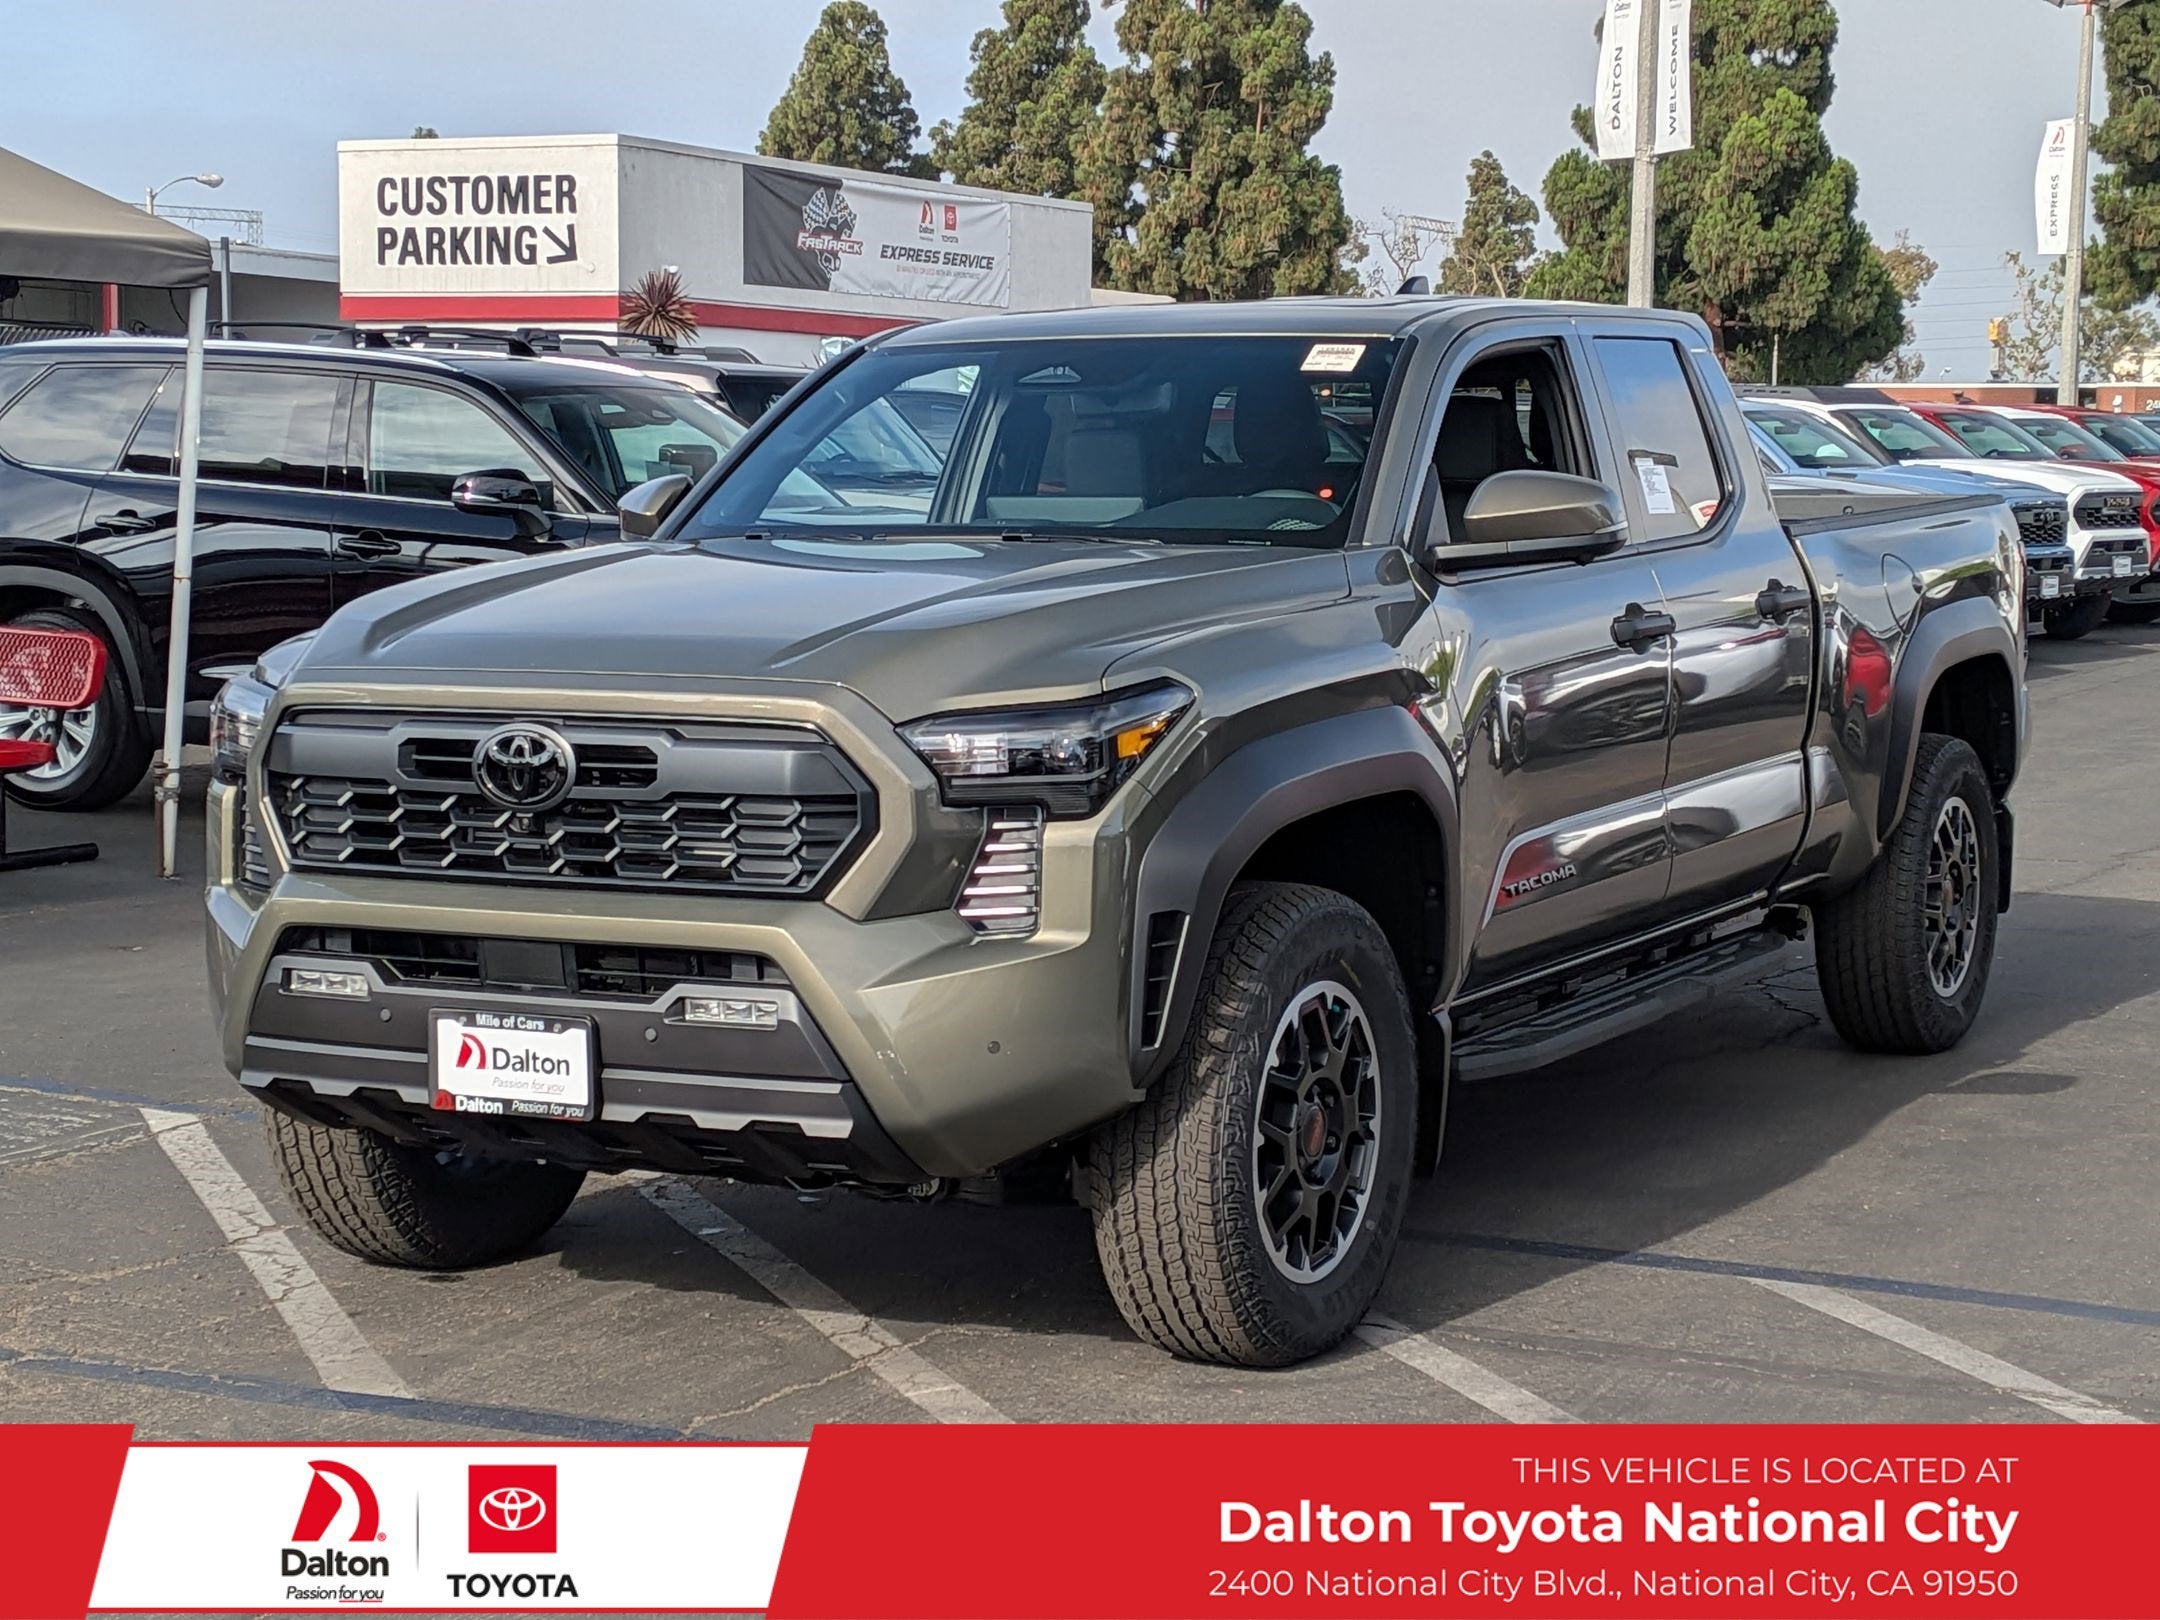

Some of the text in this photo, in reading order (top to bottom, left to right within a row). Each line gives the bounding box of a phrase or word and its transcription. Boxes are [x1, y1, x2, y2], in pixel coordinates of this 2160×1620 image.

[1611, 46, 1624, 130] DALTON
[1668, 24, 1680, 136] WELCOME
[377, 175, 578, 216] CUSTOMER
[2049, 174, 2060, 237] EXPRESS
[377, 226, 538, 266] PARKING
[880, 244, 995, 271] EXPRESS SERVICE
[1505, 863, 1577, 897] TACOMA
[475, 1013, 545, 1031] Mile of Cars
[492, 1047, 570, 1076] Dalton
[492, 1077, 566, 1093] Passion for you
[454, 1096, 504, 1115] Dalton
[511, 1100, 585, 1118] Passion for you
